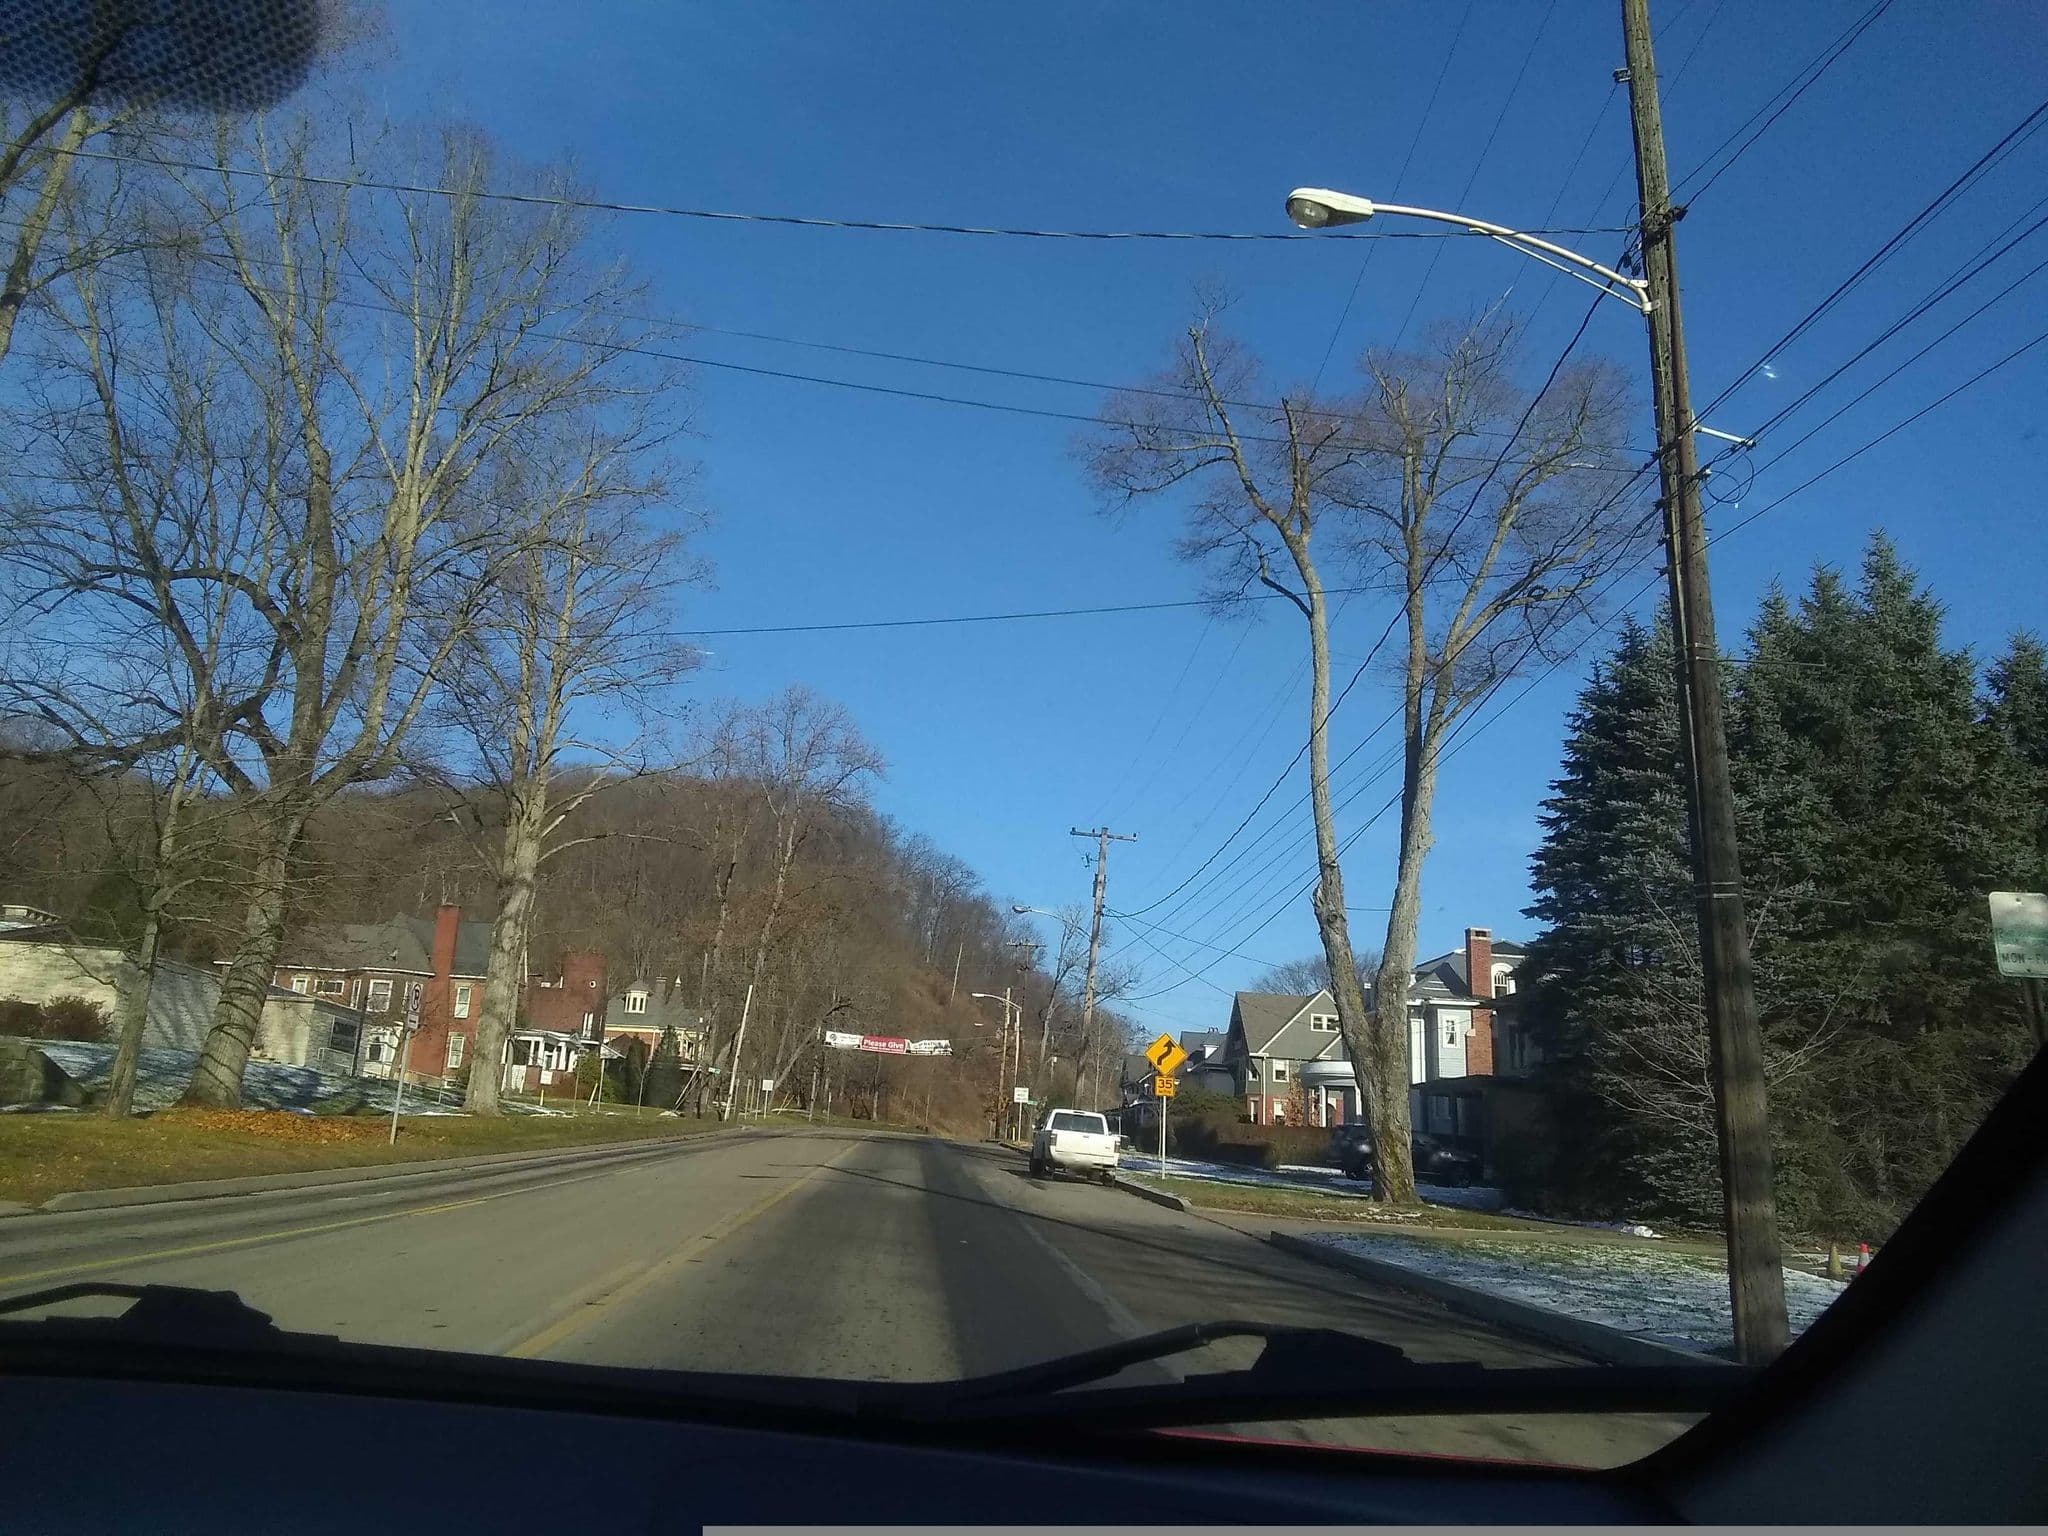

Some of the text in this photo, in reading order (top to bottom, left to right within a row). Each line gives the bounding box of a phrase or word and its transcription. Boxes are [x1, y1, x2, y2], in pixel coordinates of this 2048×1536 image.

[863, 1039, 887, 1048] Please
[888, 1041, 904, 1049] Give
[1158, 1079, 1172, 1089] 35
